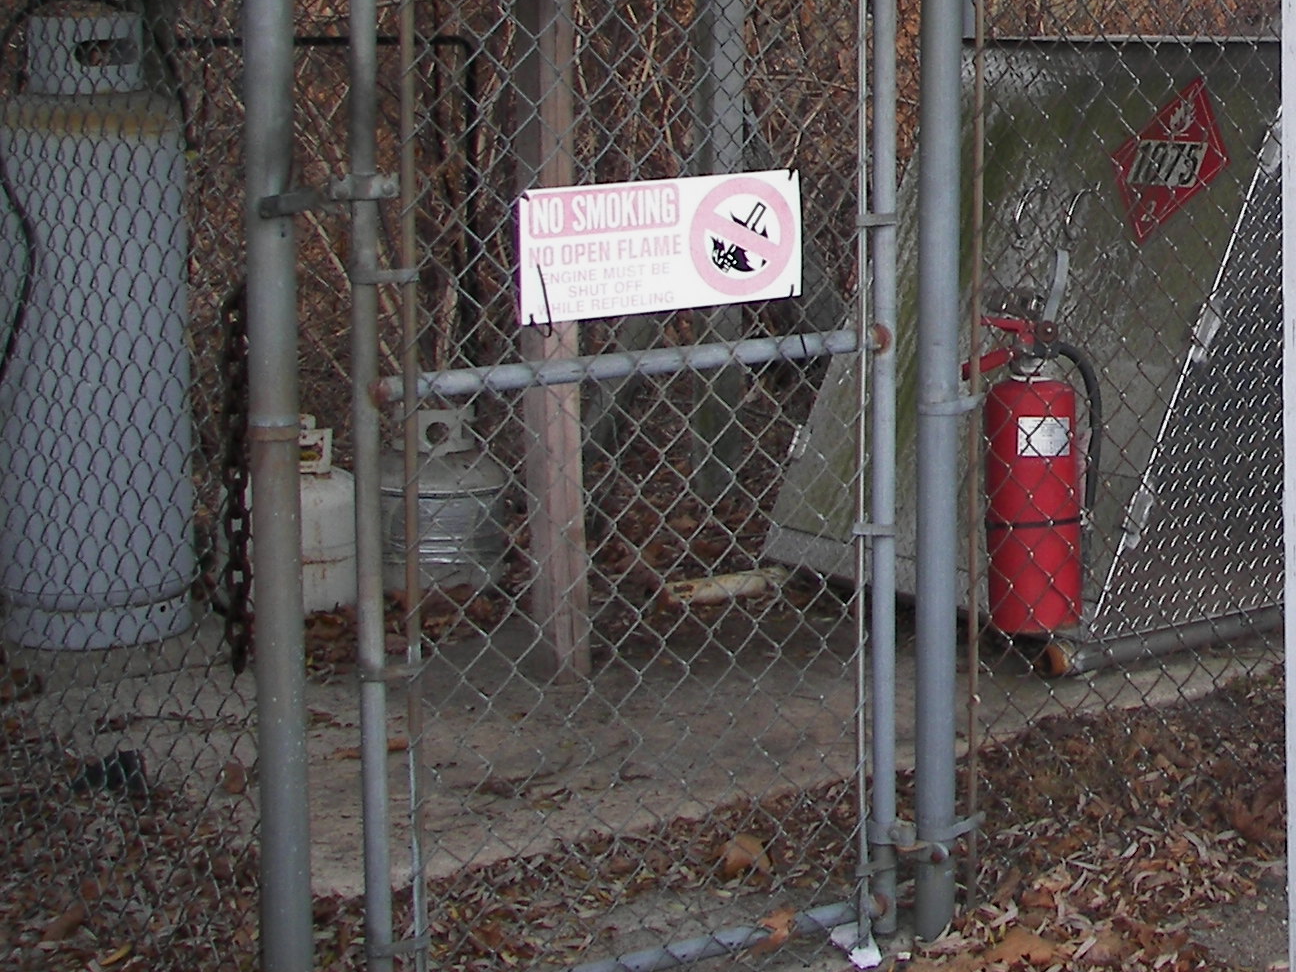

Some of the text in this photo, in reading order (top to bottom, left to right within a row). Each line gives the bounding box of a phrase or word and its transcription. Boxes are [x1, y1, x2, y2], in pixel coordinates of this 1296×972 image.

[1131, 141, 1204, 185] 1075
[532, 187, 676, 234] NO SMOKING
[528, 234, 682, 268] NO OPEN FLAME
[542, 262, 671, 285] ENGINE MUST BE
[537, 291, 675, 315] WHILE REFUELING
[568, 280, 642, 298] SHUT OFF
